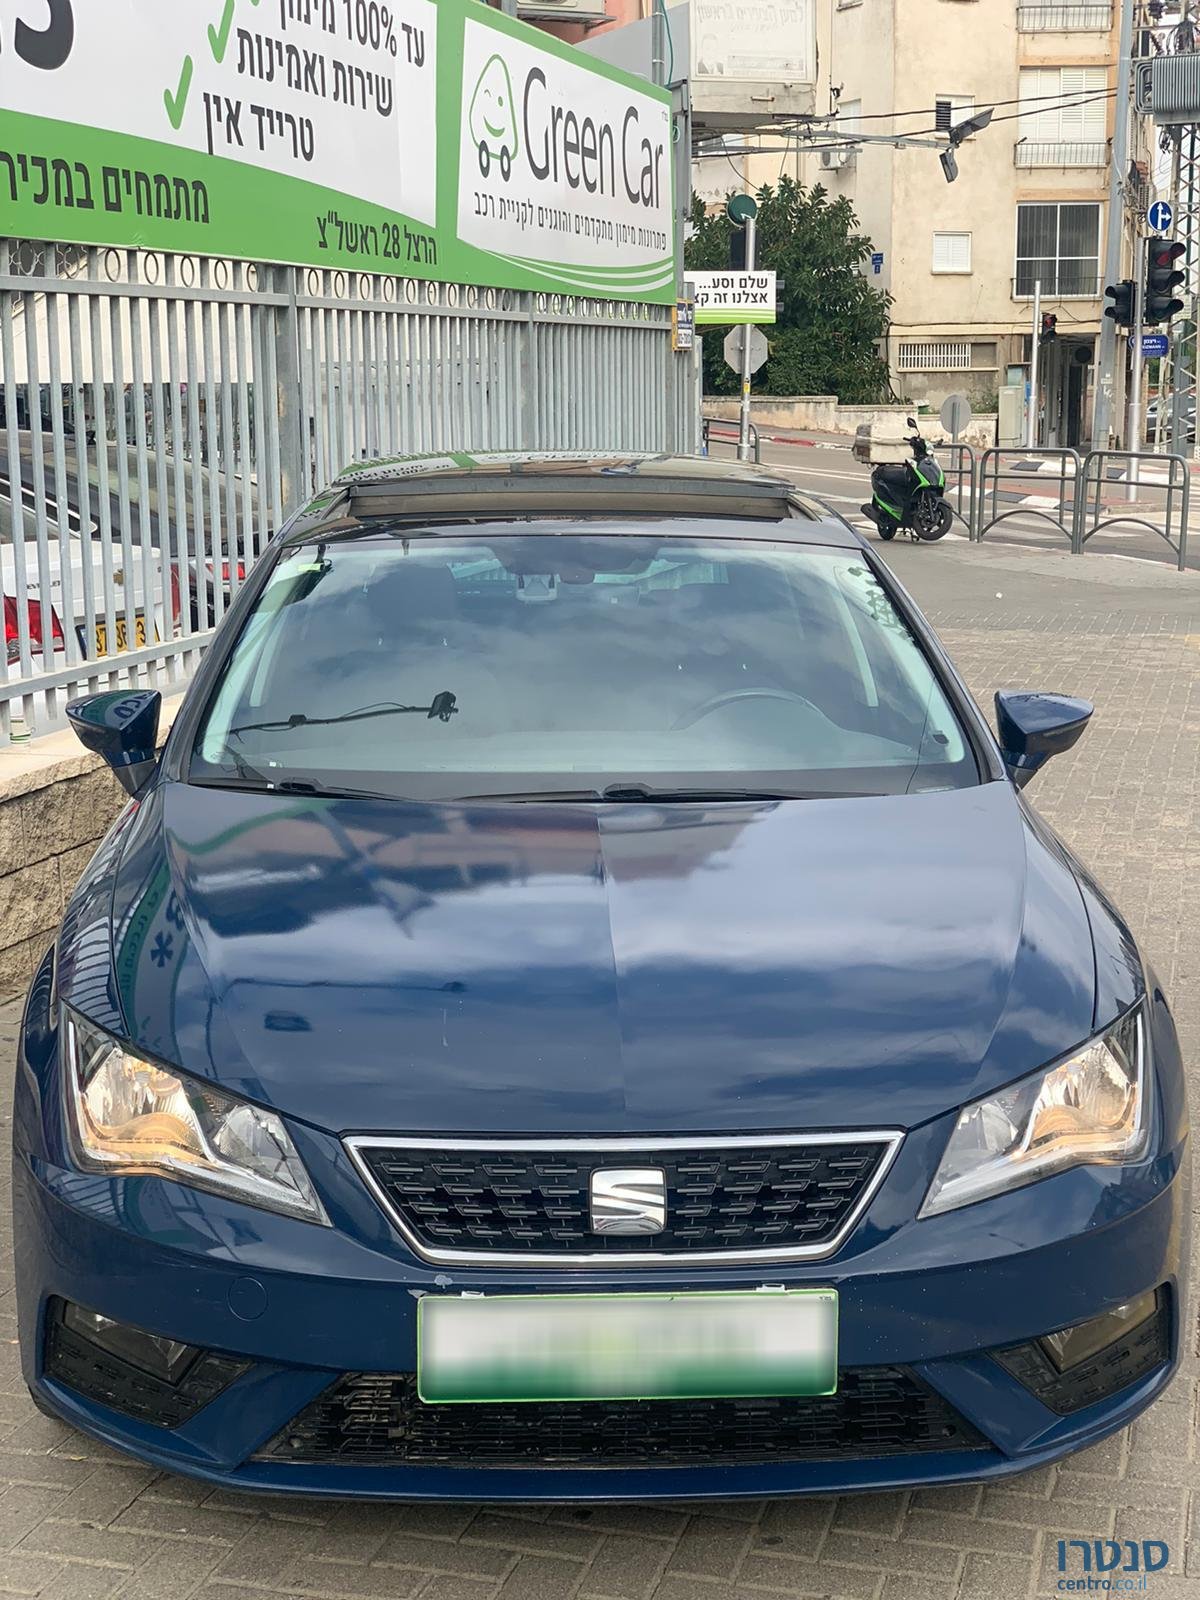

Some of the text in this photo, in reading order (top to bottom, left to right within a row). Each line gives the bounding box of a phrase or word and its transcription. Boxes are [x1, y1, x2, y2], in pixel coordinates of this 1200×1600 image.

[342, 0, 397, 57] 100%
[402, 22, 425, 67] עד
[236, 27, 393, 117] שירות ואמינות
[202, 92, 315, 162] טרייד אין
[523, 66, 664, 209] Green Car
[101, 165, 210, 224] מתמחים
[474, 191, 667, 251] פתרונות מימון מתקדמים והוגנים לקניית רכב
[316, 210, 437, 265] הרצל 28 ראשל"צ
[699, 275, 768, 289] שלם וסע...
[714, 292, 728, 303] זה
[732, 290, 768, 303] אצלנו
